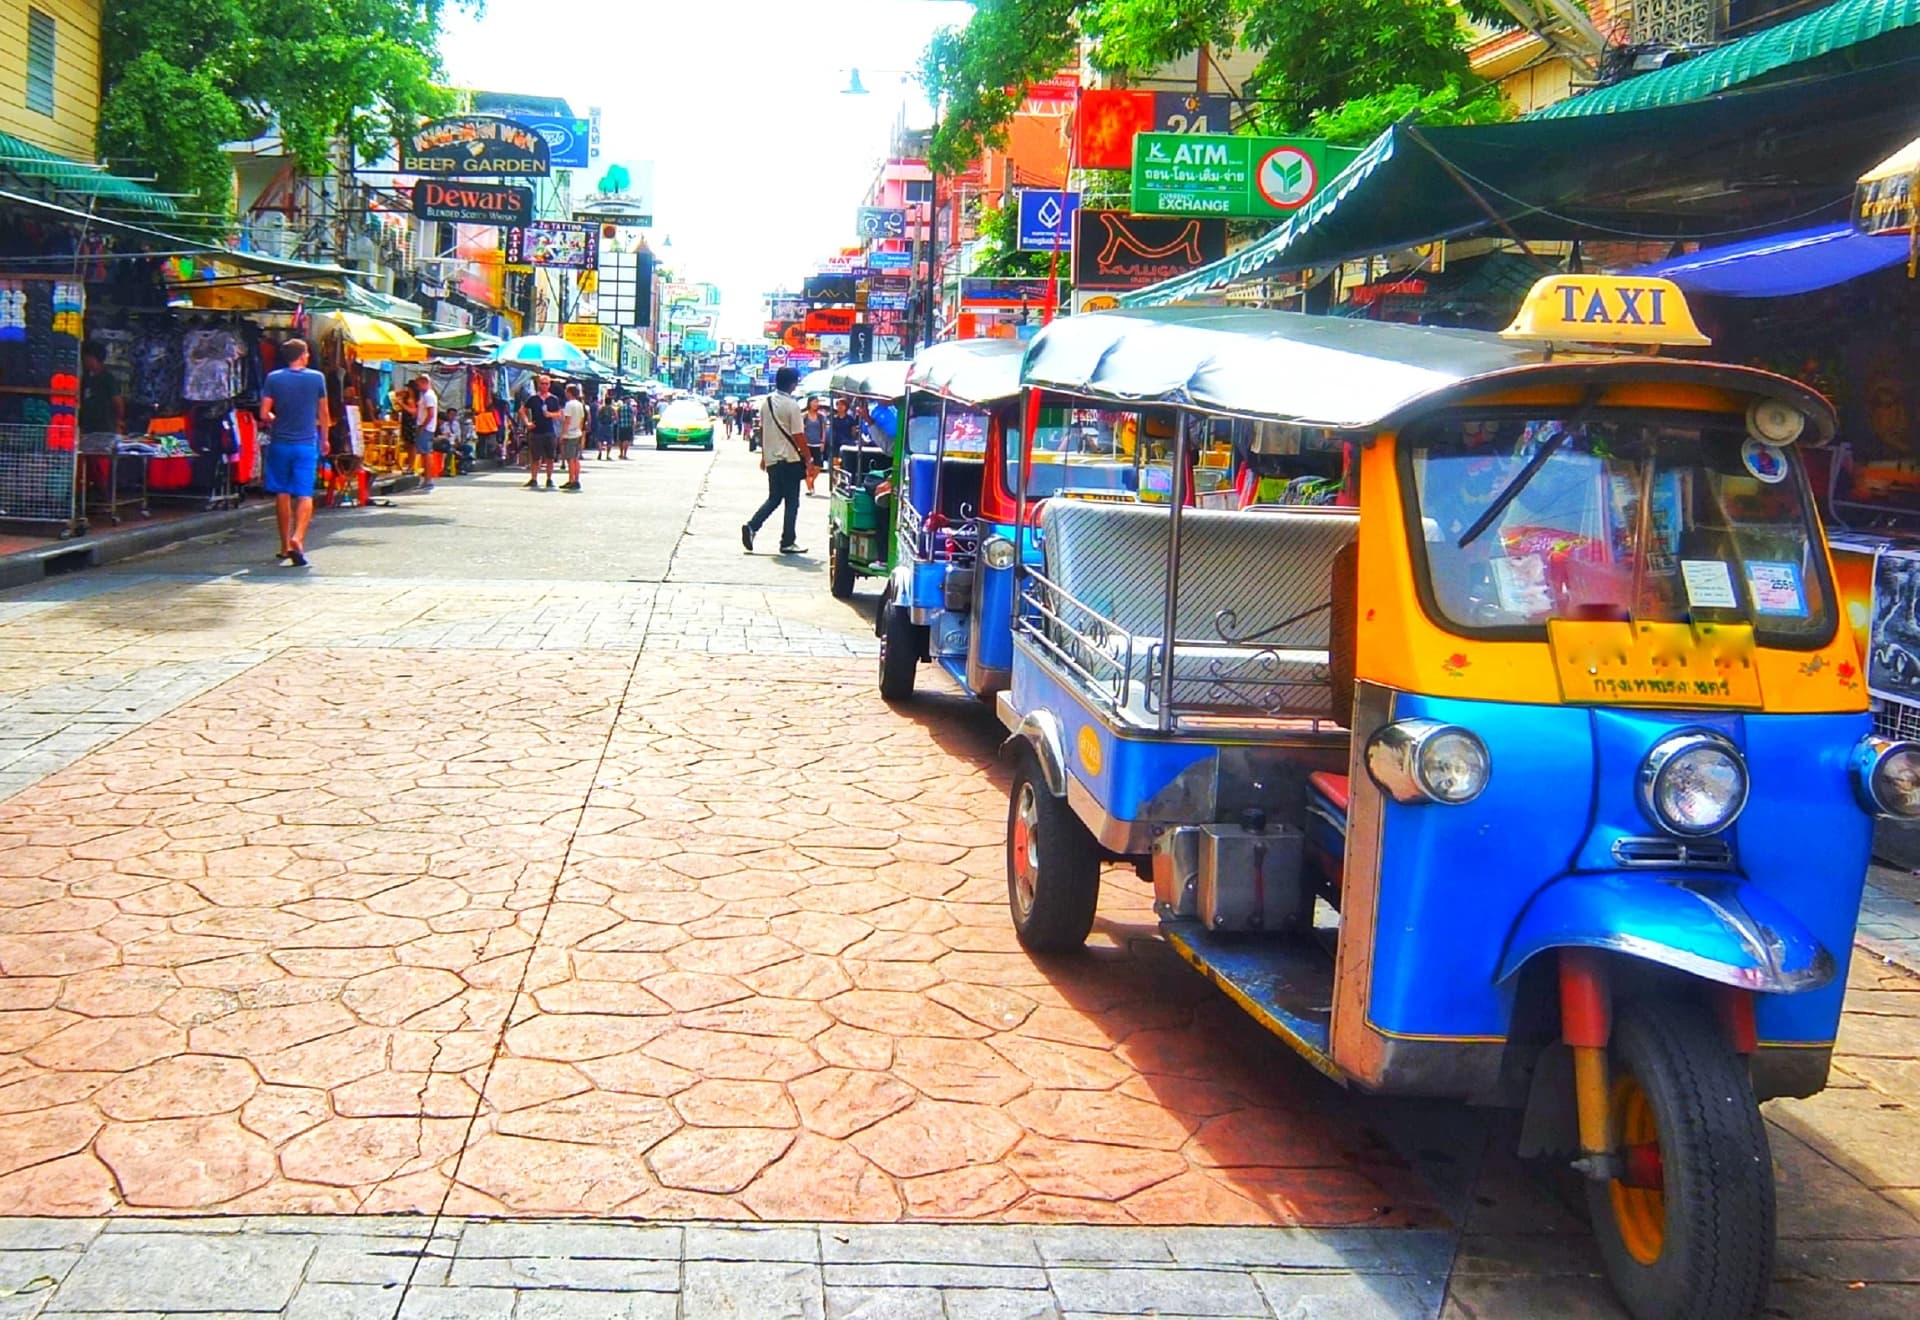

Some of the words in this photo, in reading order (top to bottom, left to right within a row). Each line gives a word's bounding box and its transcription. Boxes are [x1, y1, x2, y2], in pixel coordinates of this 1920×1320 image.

[1173, 143, 1228, 165] ATM
[404, 157, 456, 171] BEER
[463, 158, 546, 172] GARDEN
[1158, 192, 1195, 200] CURRENCY
[1158, 199, 1230, 212] EXCHANGE
[508, 226, 520, 263] ATTOO
[1554, 285, 1667, 325] TAXI
